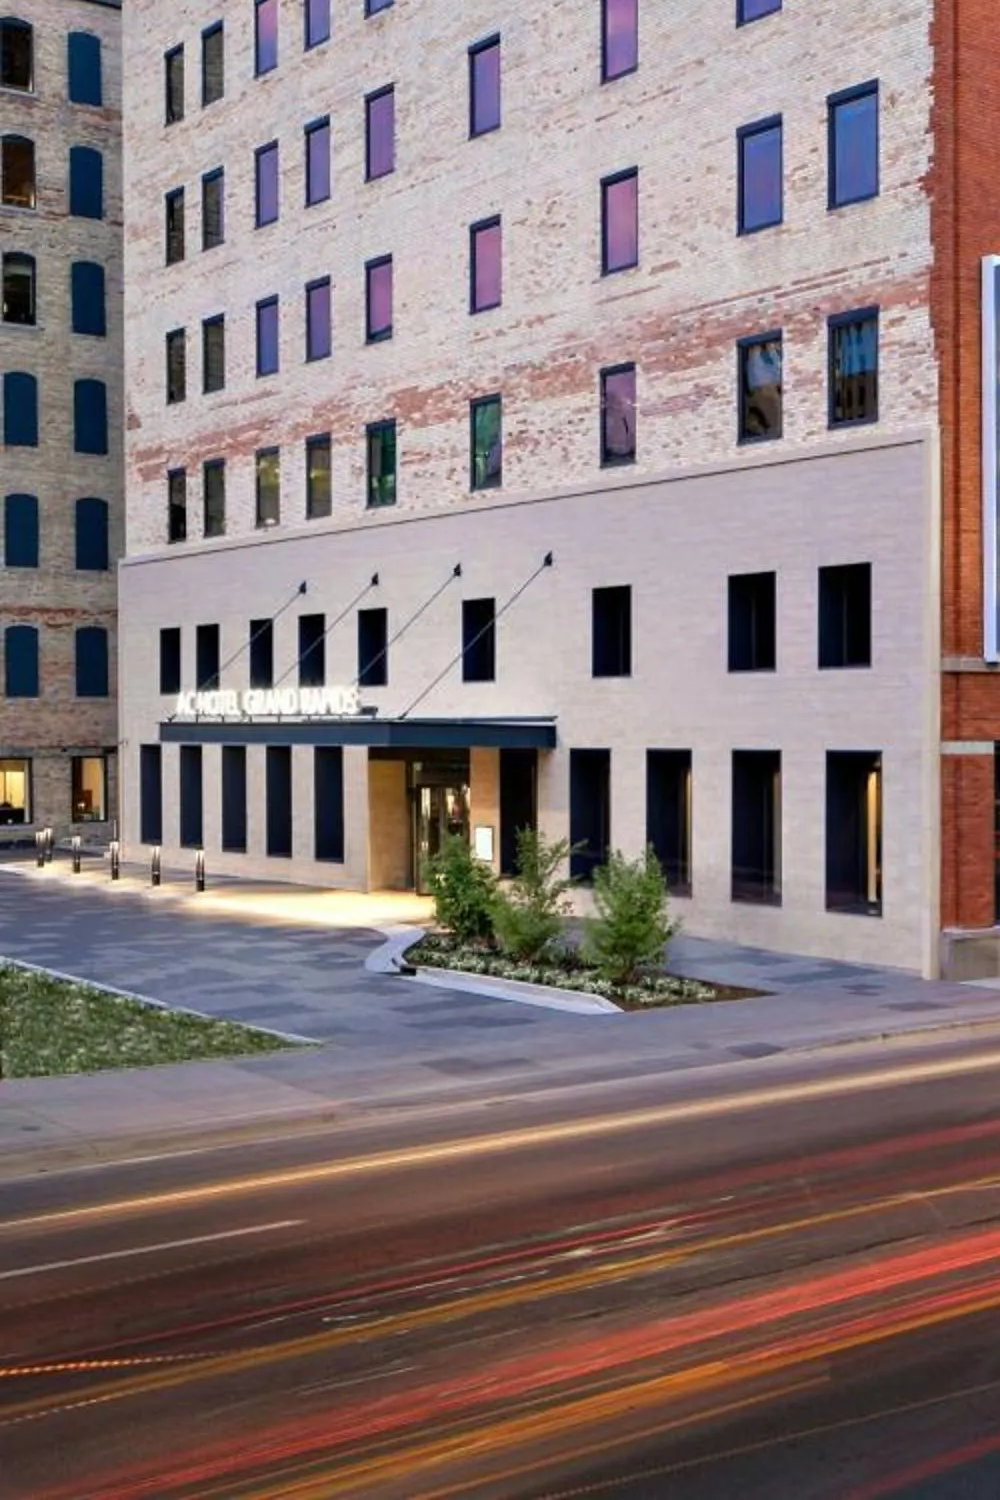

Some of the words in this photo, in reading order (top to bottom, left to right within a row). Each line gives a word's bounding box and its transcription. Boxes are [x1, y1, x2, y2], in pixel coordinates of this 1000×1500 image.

[176, 691, 196, 715] AC
[197, 690, 240, 715] HOTEL
[243, 687, 298, 714] GRAND
